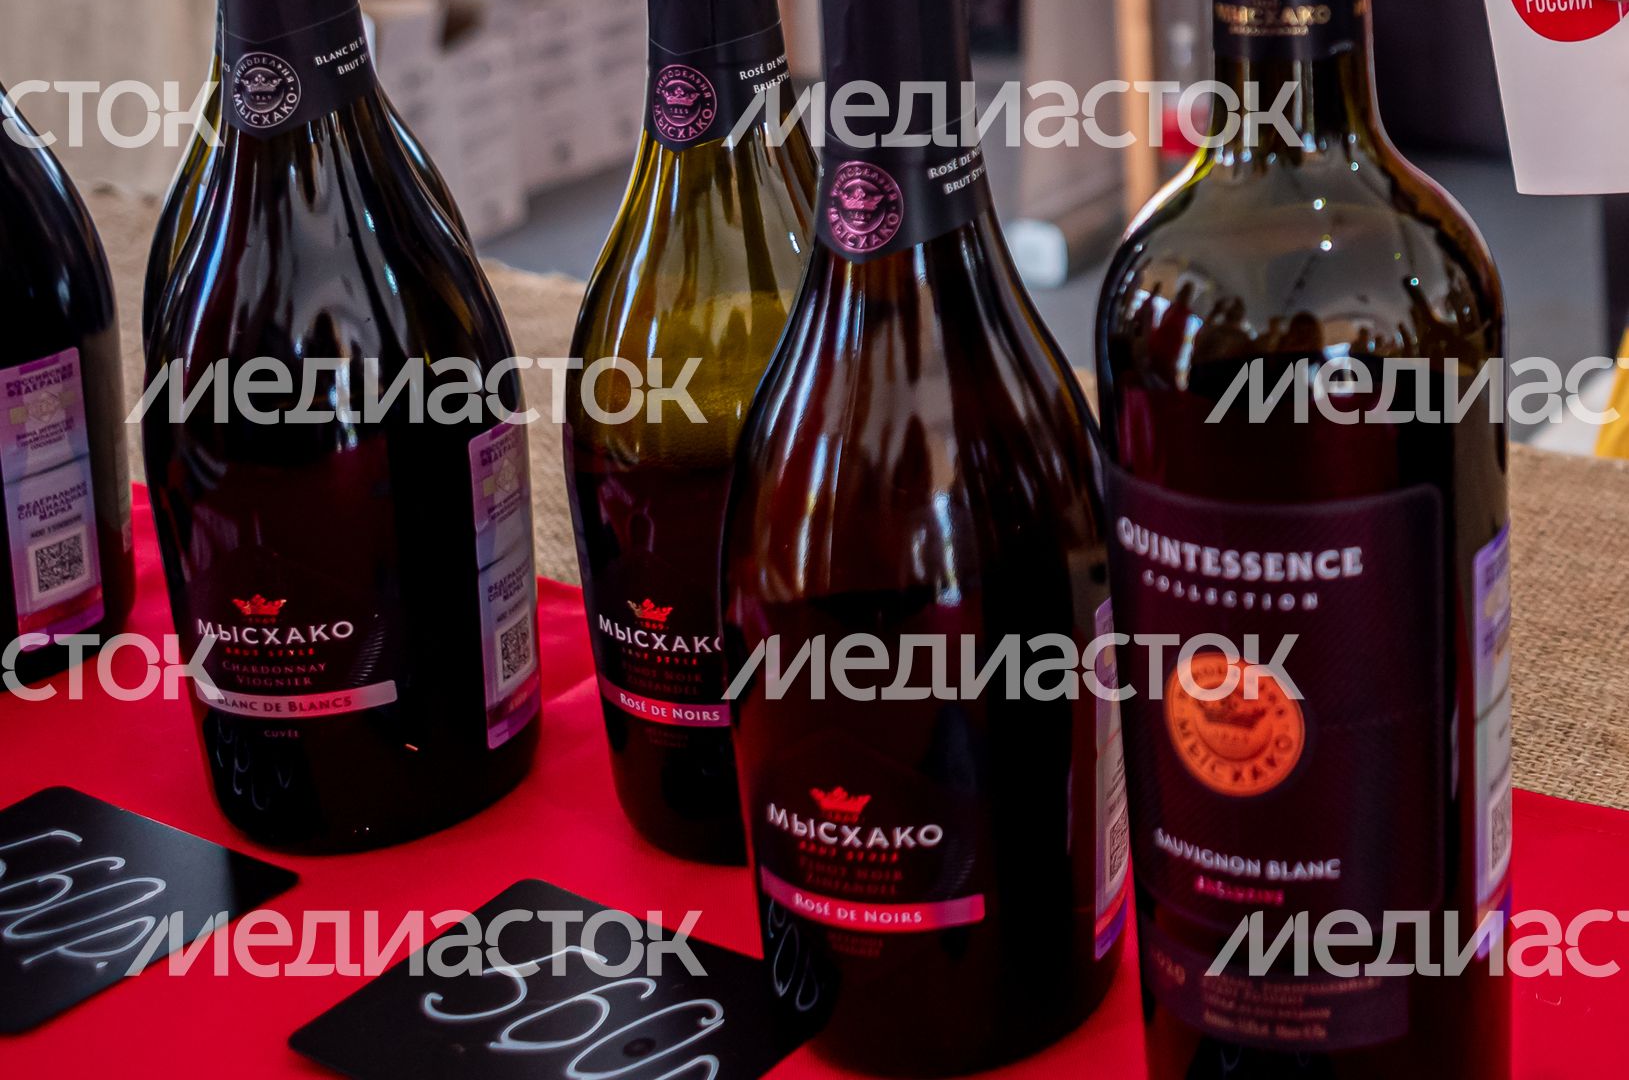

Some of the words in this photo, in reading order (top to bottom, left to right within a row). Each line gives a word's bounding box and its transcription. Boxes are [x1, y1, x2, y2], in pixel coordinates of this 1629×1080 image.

[314, 47, 349, 66] BLANC
[739, 64, 765, 81] ROSÉ
[233, 93, 297, 125] МЫСХАКО
[928, 158, 958, 179] ROSÉ
[944, 178, 970, 195] BRUT
[1117, 516, 1364, 582] QUINTESSENCE
[1142, 569, 1320, 611] COLLECTION
[198, 618, 354, 647] МЫСХАКО
[264, 701, 282, 712] DE
[288, 696, 353, 713] BLANCS
[620, 693, 647, 712] ROSÉ
[651, 705, 668, 717] DE
[672, 708, 720, 721] NOIRS
[767, 802, 944, 849] МЫСХАКО
[1153, 826, 1261, 878] SAUVIGNON
[1265, 858, 1342, 881] BLANC
[793, 891, 831, 916] ROSÉ
[837, 906, 857, 922] DE
[864, 909, 923, 925] NOIRS
